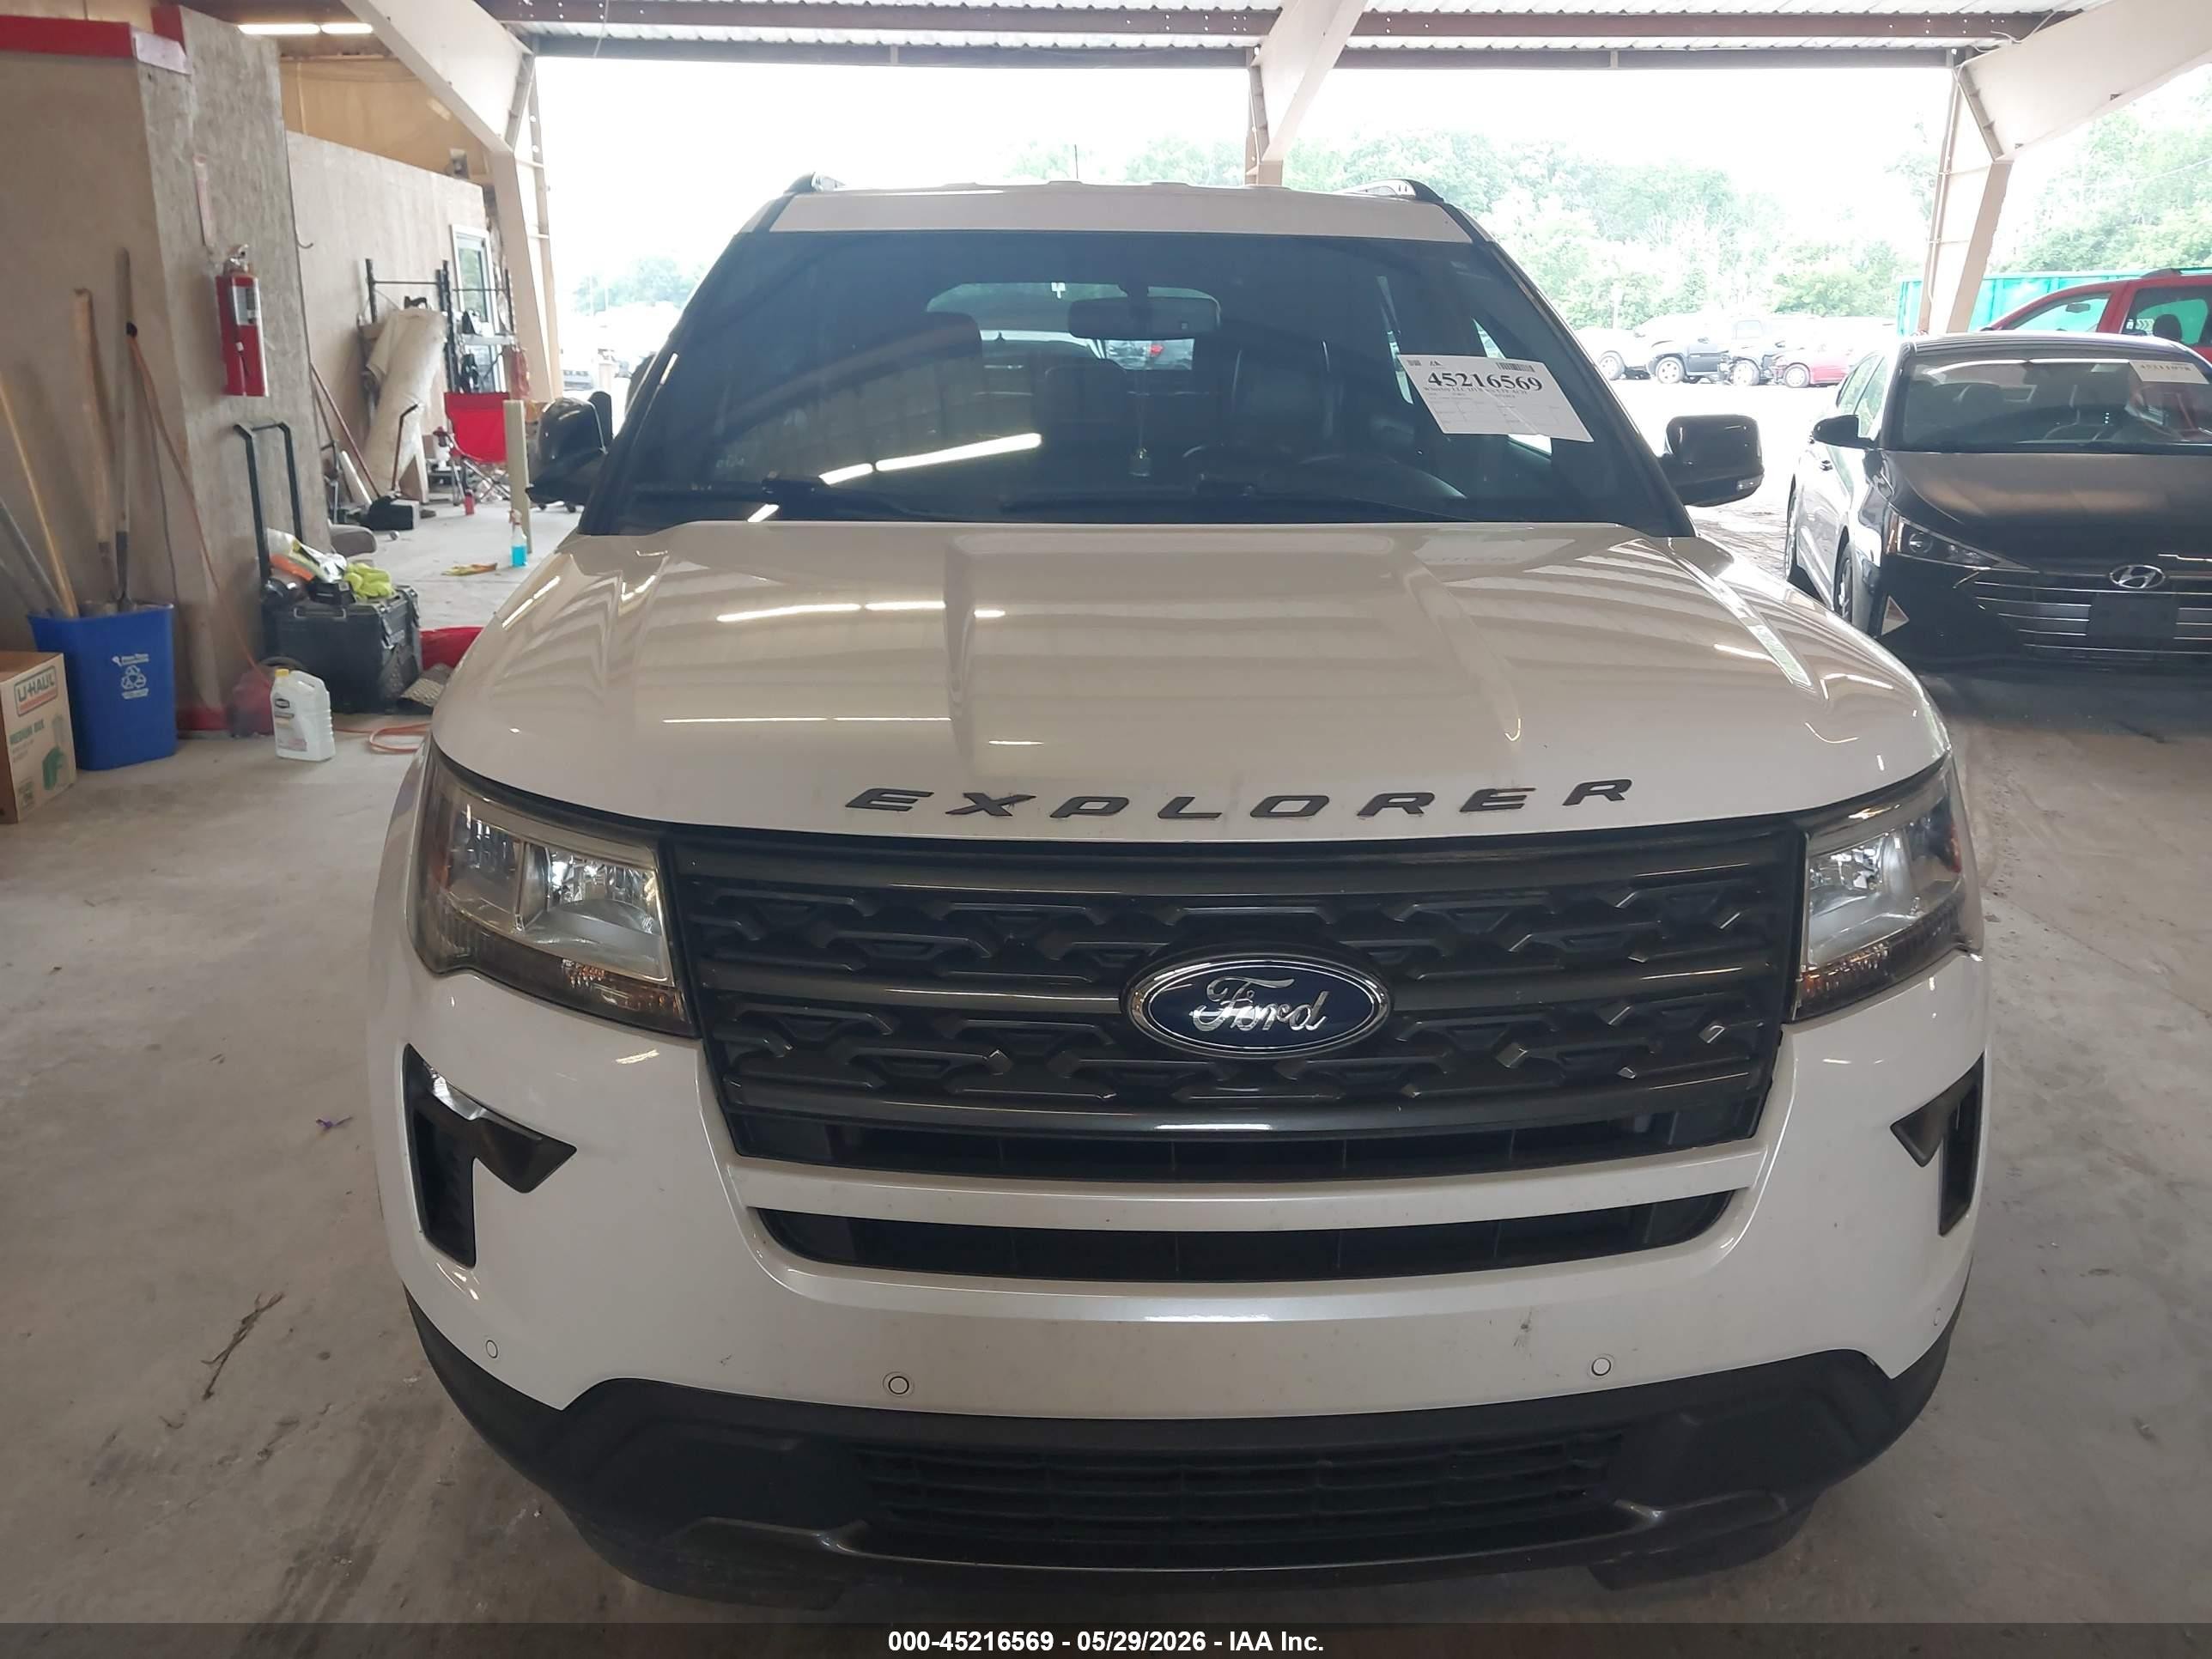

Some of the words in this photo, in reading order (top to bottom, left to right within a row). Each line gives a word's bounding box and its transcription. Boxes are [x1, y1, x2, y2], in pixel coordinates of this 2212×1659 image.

[1427, 372, 1543, 392] 45216569
[845, 779, 1633, 820] EXPLORER
[1188, 975, 1330, 1032] Ford
